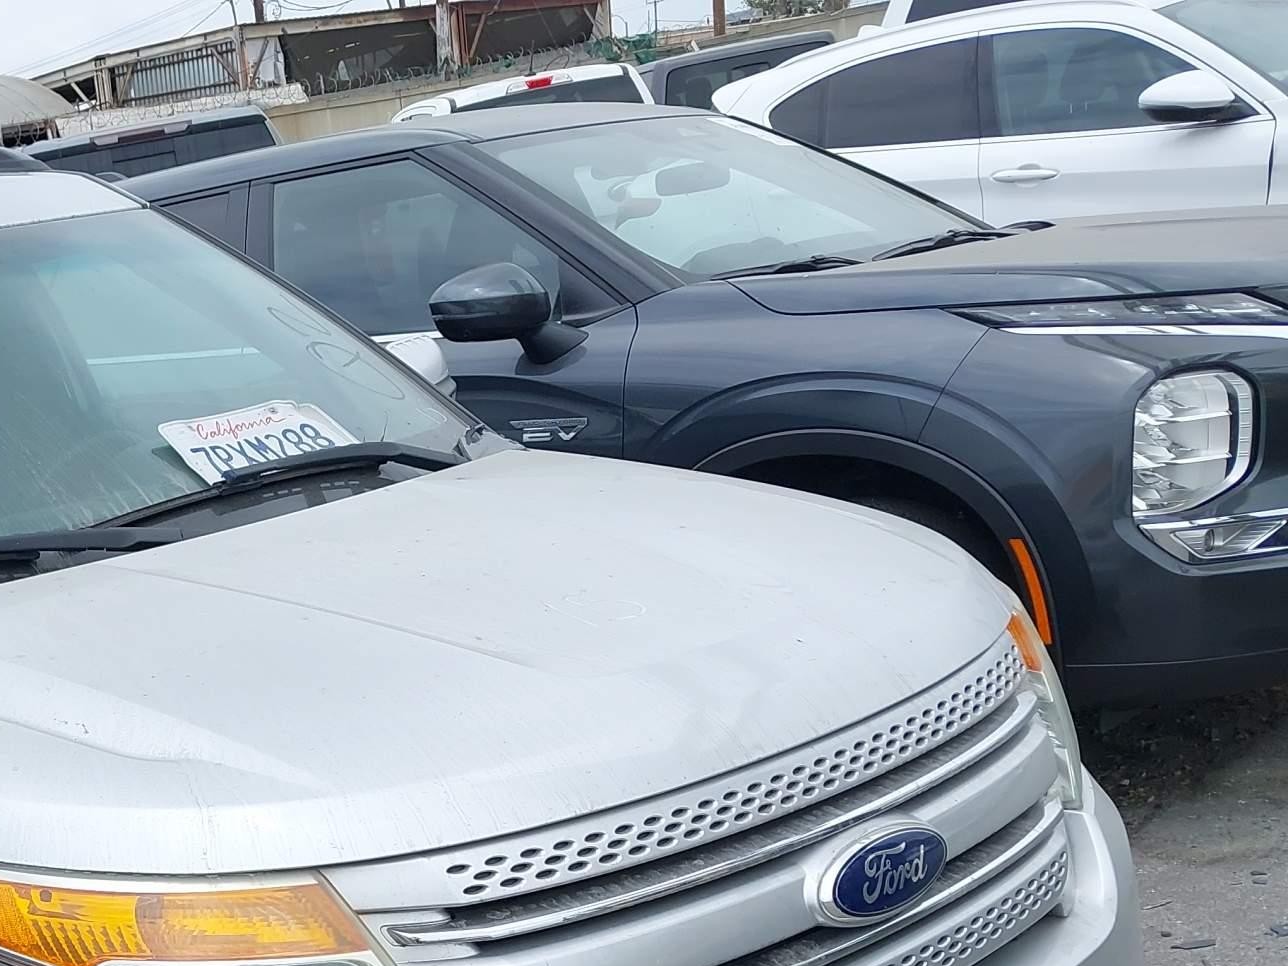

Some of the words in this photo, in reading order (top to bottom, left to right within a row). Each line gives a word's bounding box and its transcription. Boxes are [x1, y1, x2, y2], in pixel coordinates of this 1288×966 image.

[190, 423, 336, 475] 7PXM288
[196, 414, 286, 440] California
[862, 841, 928, 904] Ford
